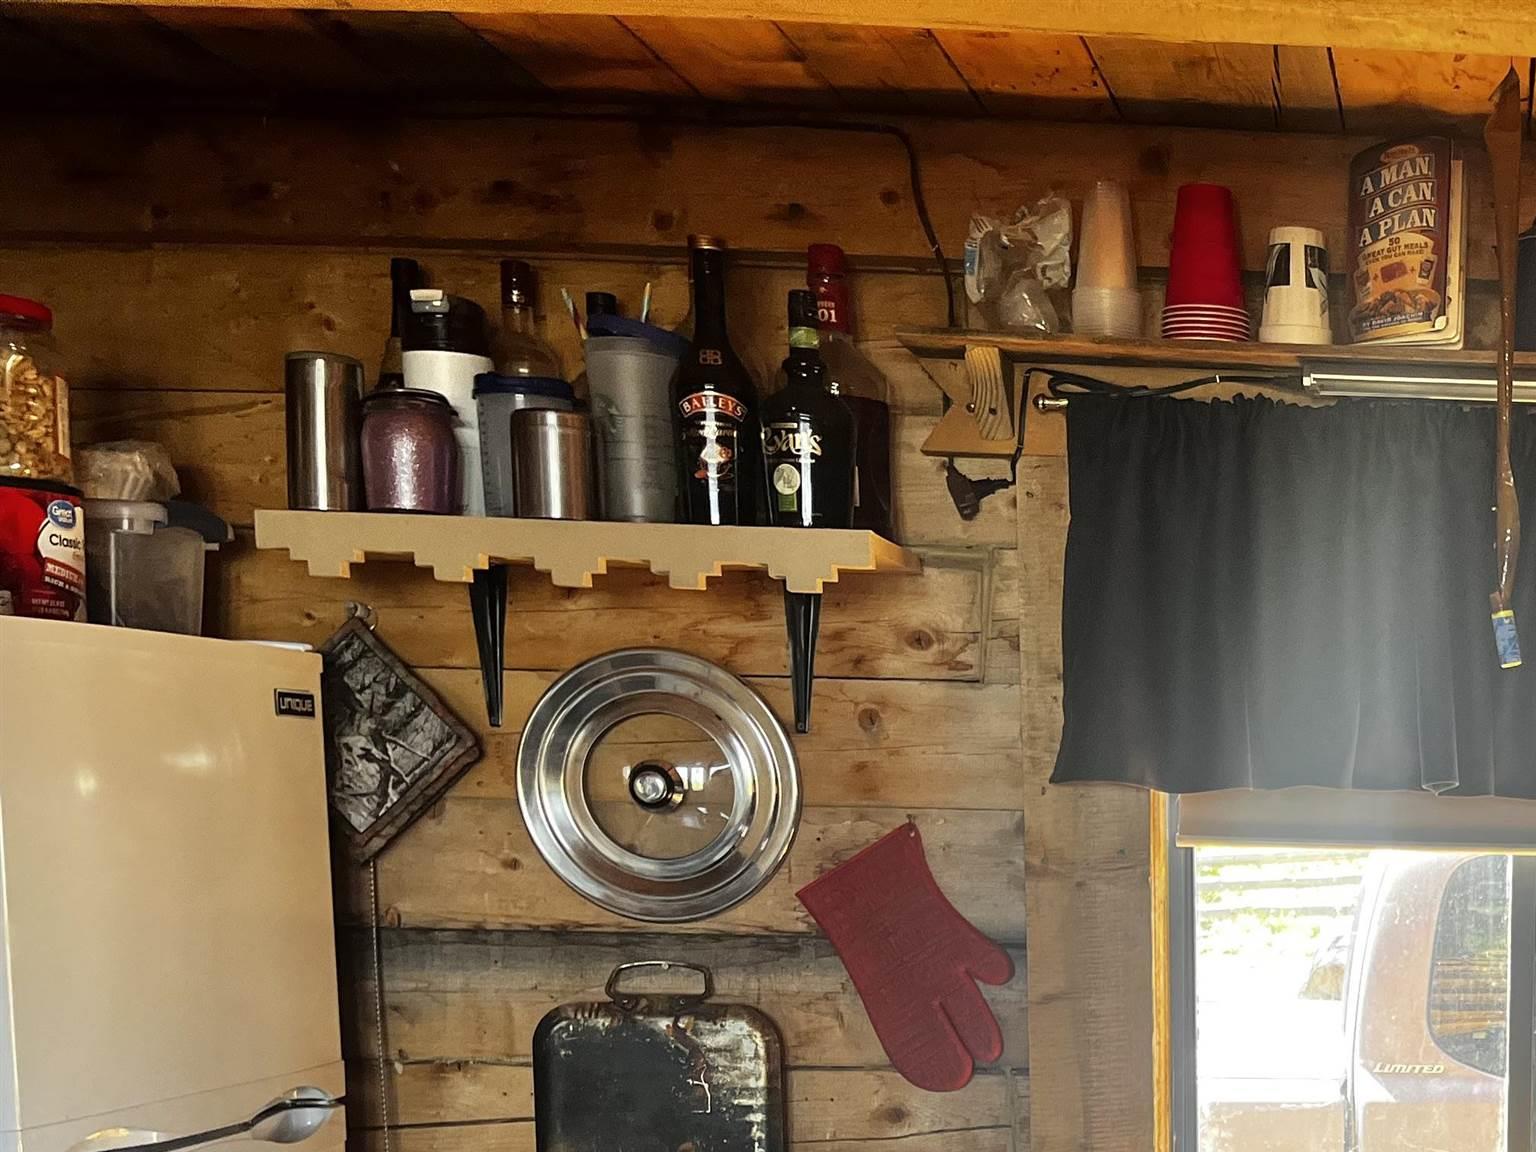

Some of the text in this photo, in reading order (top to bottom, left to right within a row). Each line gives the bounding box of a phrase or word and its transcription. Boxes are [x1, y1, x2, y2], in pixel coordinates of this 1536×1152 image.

[1360, 157, 1432, 196] A MAN,
[1368, 182, 1434, 218] A CAN,
[1359, 208, 1436, 248] A PLAN
[1388, 236, 1401, 247] 50
[1404, 241, 1429, 250] MEALS
[682, 393, 744, 417] BAILEYS
[279, 696, 313, 712] UNIQUE
[1373, 1062, 1445, 1074] LIMITED
